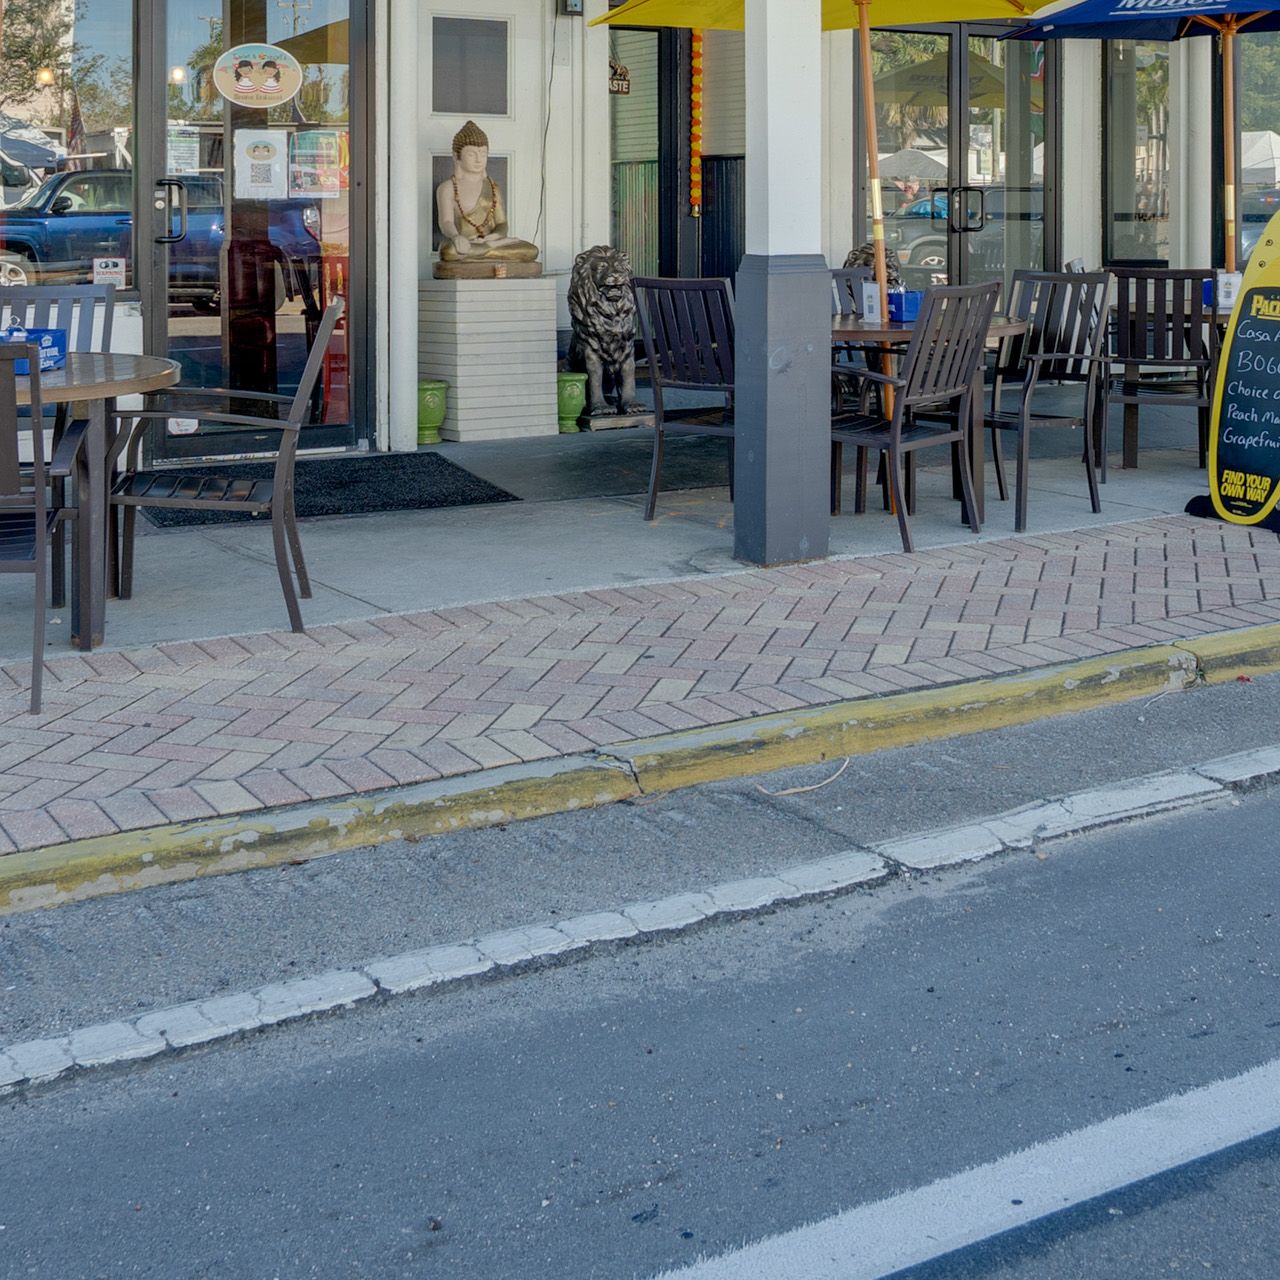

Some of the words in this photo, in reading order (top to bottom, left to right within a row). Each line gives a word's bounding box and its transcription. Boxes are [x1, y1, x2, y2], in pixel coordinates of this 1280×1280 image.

[1237, 319, 1271, 342] Casa
[1227, 380, 1269, 400] Choice
[1227, 402, 1258, 423] Peach
[1222, 469, 1246, 485] FIND
[1246, 472, 1272, 490] YOUR
[1220, 482, 1246, 499] OWN
[1246, 486, 1269, 503] WAY
